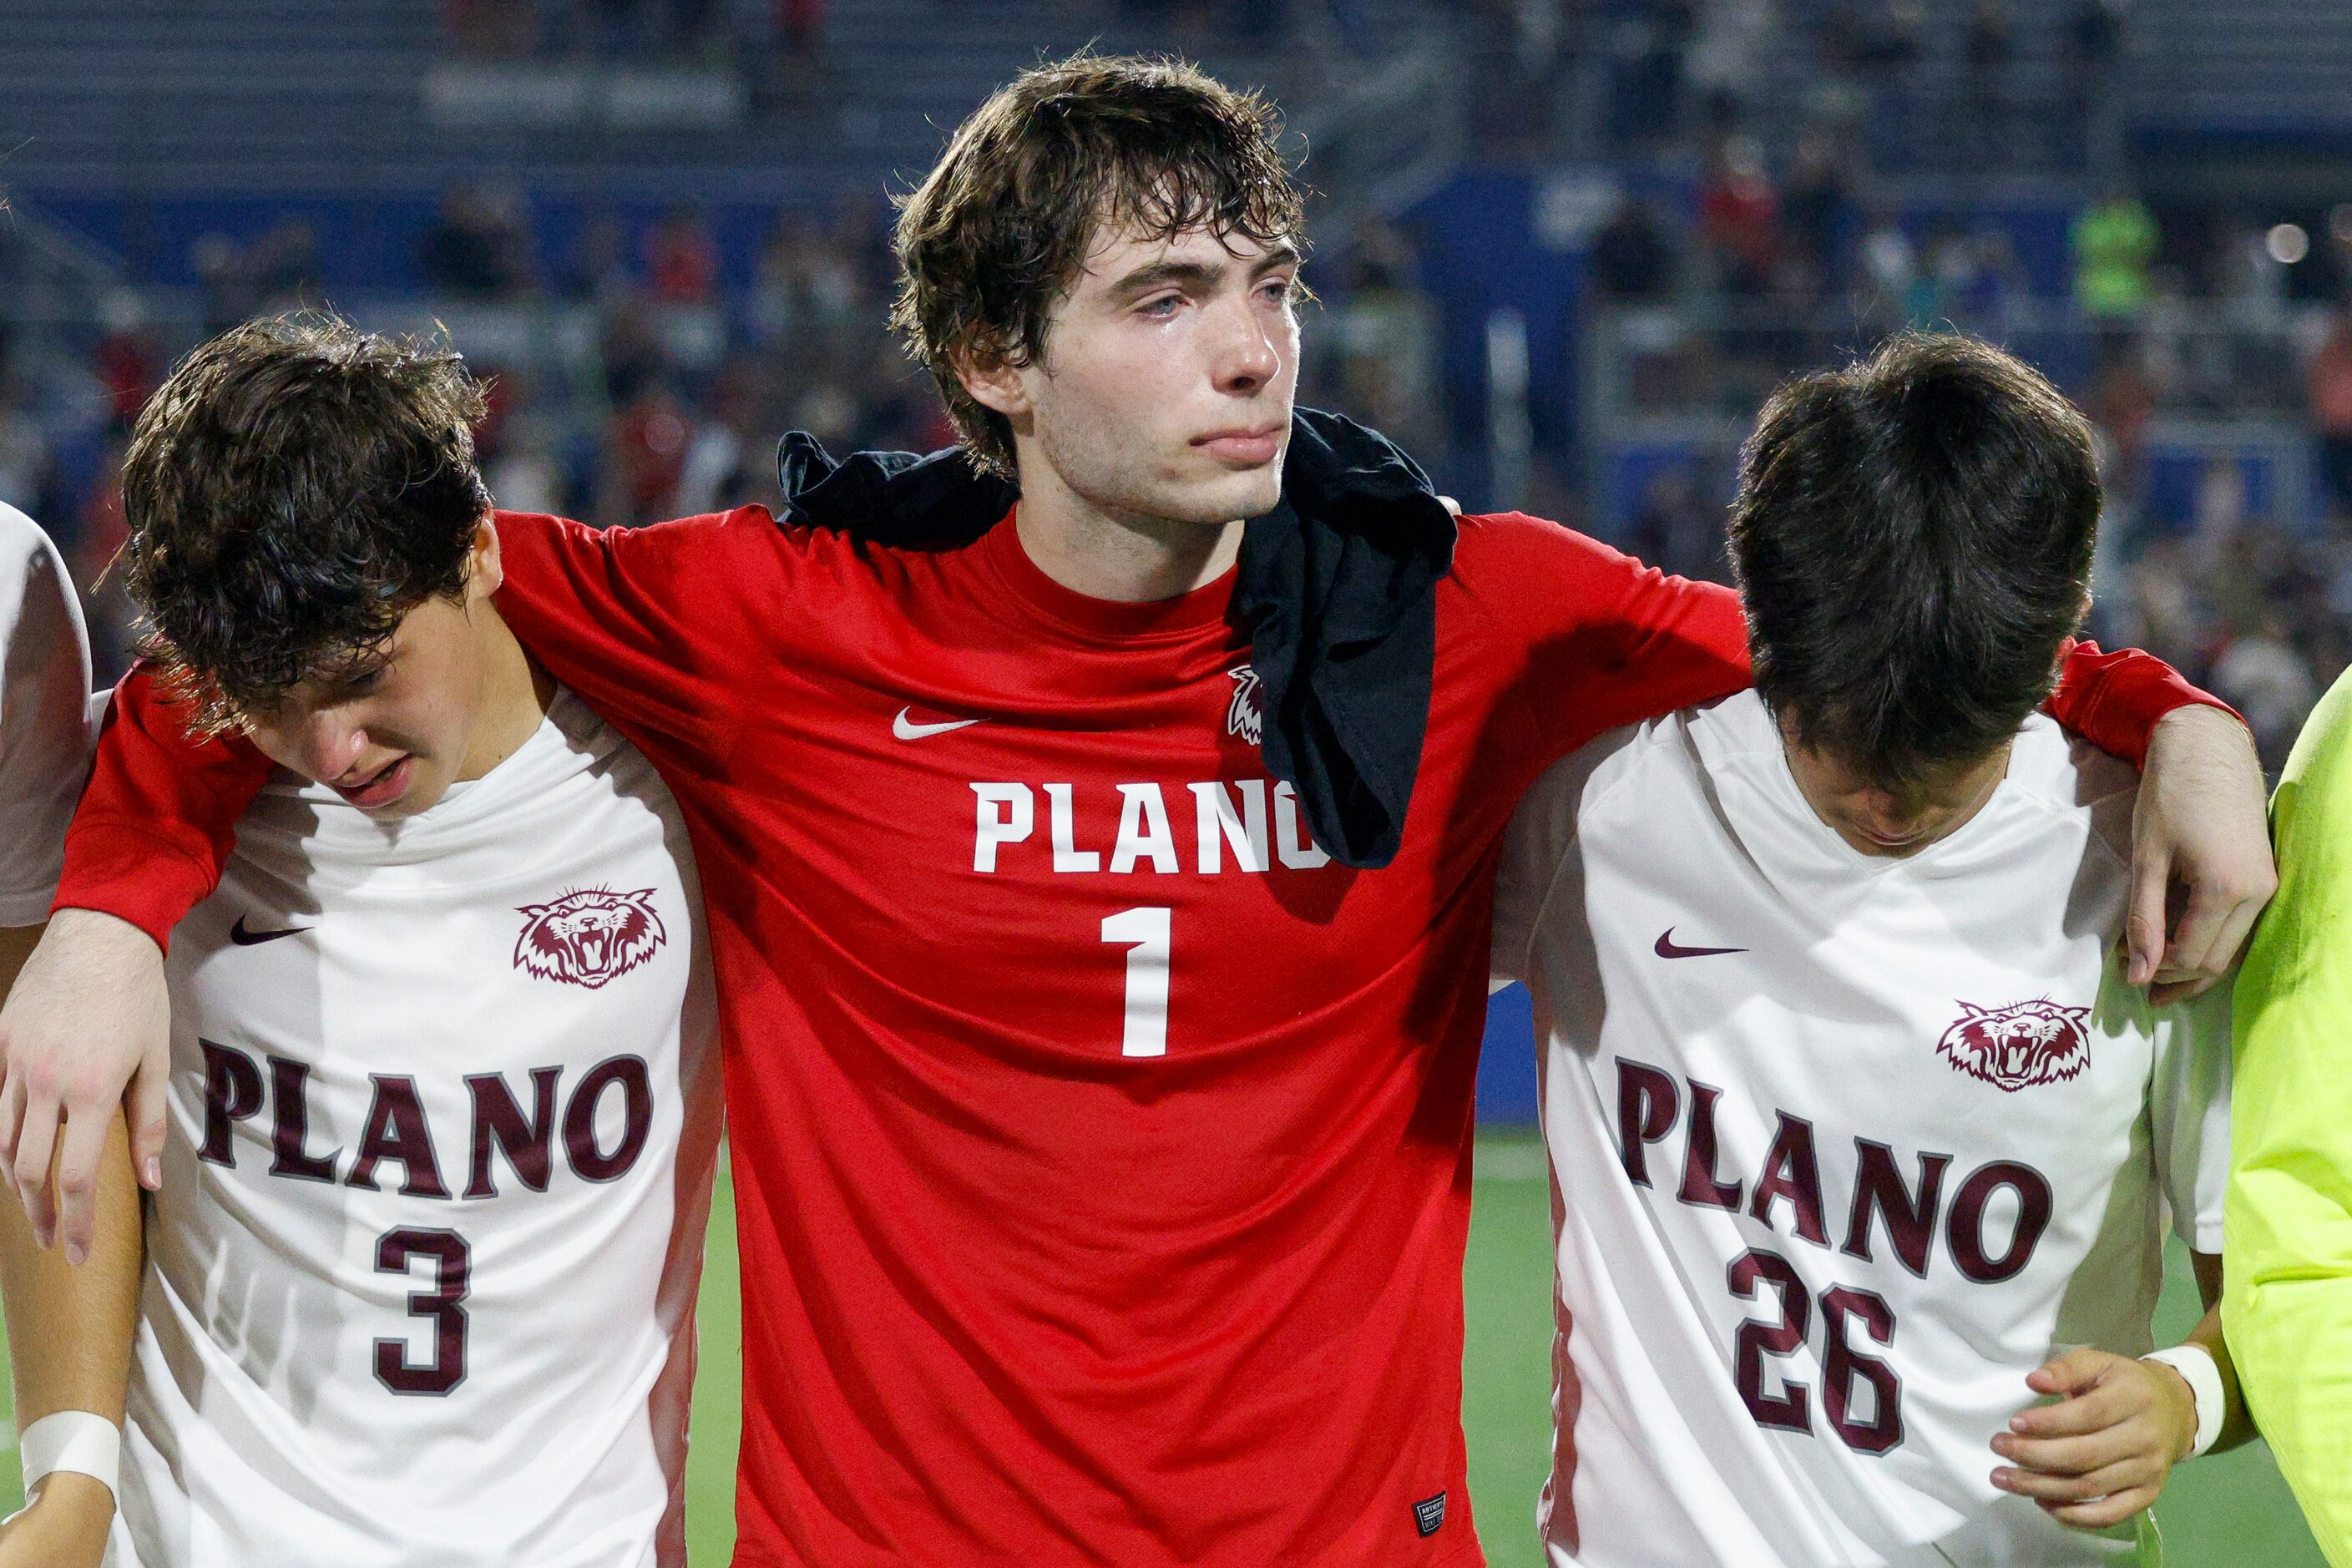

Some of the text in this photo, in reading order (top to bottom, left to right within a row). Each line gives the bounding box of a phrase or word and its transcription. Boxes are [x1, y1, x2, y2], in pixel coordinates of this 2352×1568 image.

[969, 779, 1331, 874] PLANO
[1100, 907, 1171, 1057] 1
[196, 1037, 654, 1201] PLANO
[1615, 1055, 2054, 1285] PLANO
[372, 1224, 472, 1398] 3
[1726, 1247, 1905, 1458] 26
